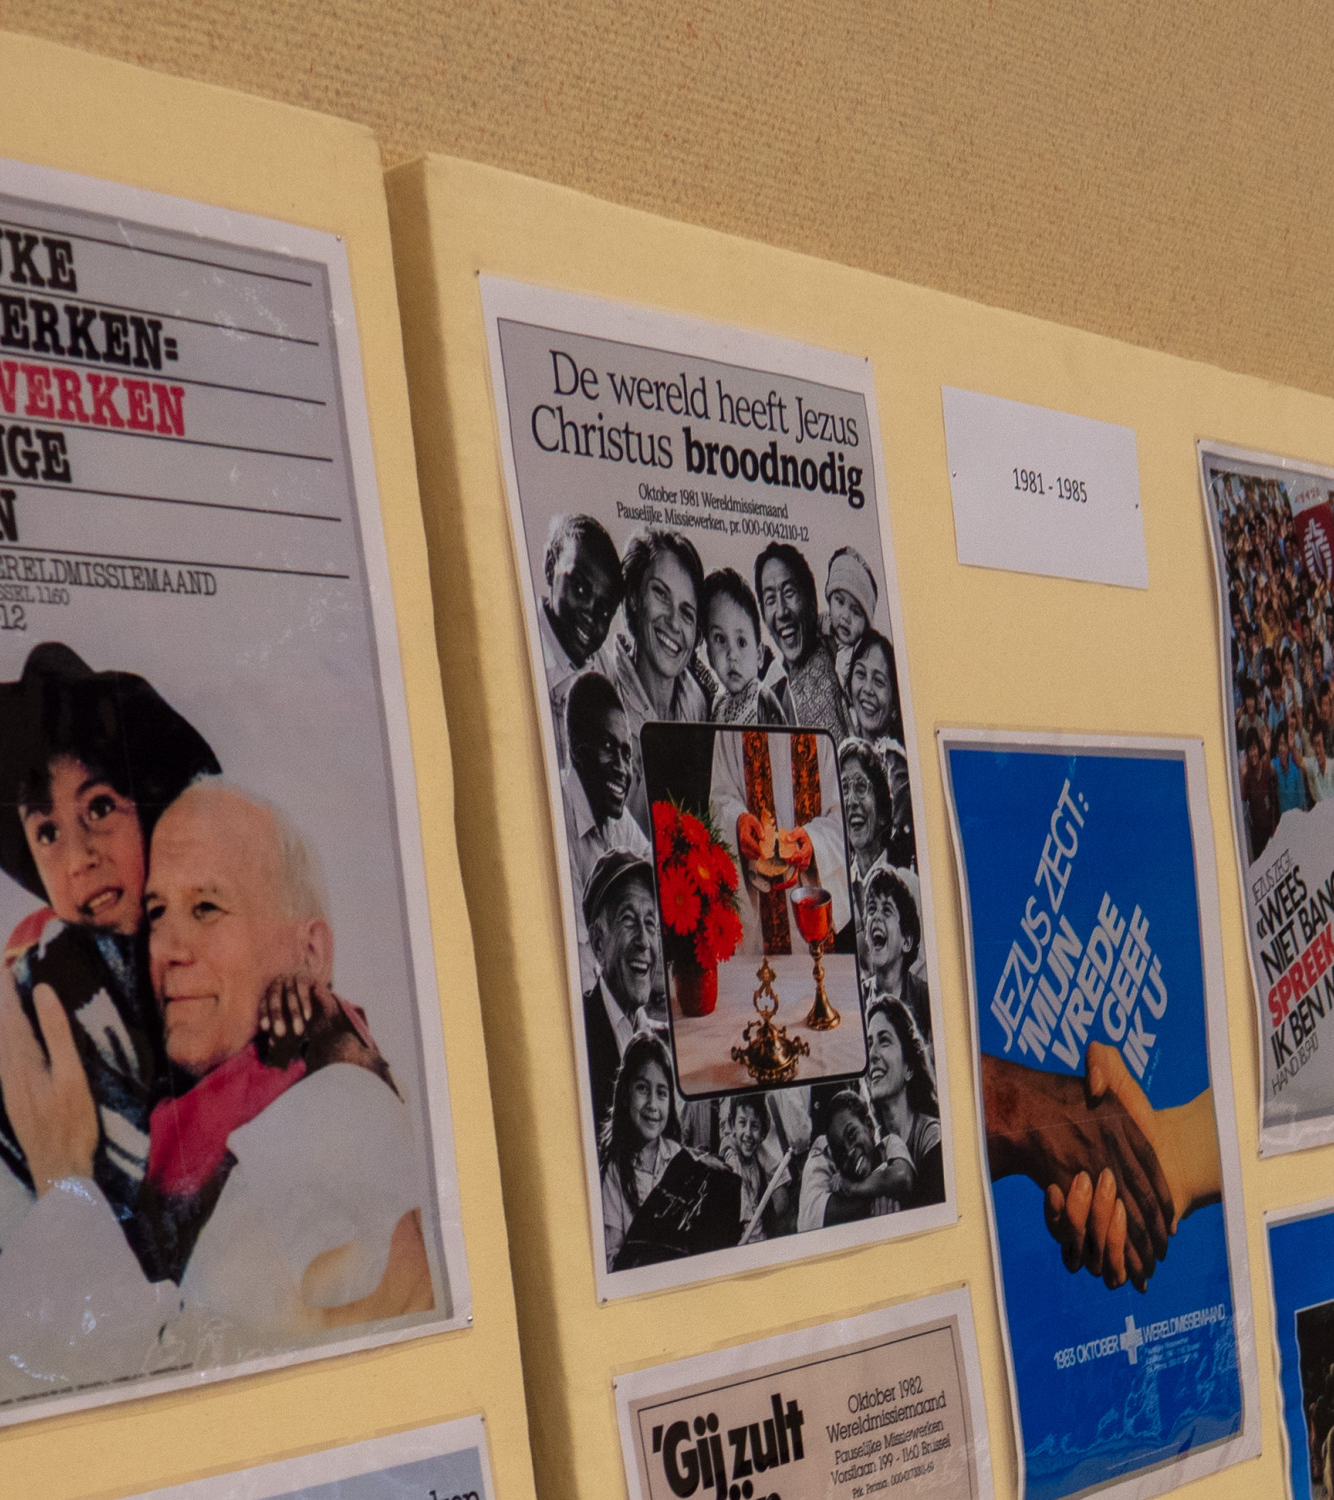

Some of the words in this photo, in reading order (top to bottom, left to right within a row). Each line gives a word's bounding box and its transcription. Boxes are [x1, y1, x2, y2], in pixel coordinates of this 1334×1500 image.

[549, 349, 599, 399] De
[607, 371, 708, 419] wereld
[716, 380, 789, 434] heeft
[795, 397, 859, 447] Jezus
[531, 404, 673, 468] Christus
[683, 427, 865, 509] broodnodig
[638, 482, 677, 506] Oktober
[679, 488, 700, 508] 1981
[702, 491, 788, 520] Wereldmissiemaand
[990, 895, 1051, 1054] JEZUS
[1034, 778, 1089, 915] ZEGT:
[1260, 919, 1300, 985] NIET
[1052, 891, 1126, 1070] VREDE
[1102, 904, 1152, 1042] GEEF
[1270, 1022, 1293, 1070] IK
[1289, 986, 1325, 1048] BEN
[1054, 1348, 1076, 1370] 1983
[1076, 1335, 1120, 1364] OKTOBER
[1143, 1303, 1225, 1343] WERELDMISSIEMAAND
[728, 1392, 805, 1481] zult
[826, 1390, 947, 1443] Wereldmissiemaand
[848, 1387, 896, 1414] Oktober
[898, 1375, 923, 1399] 1982
[834, 1439, 882, 1465] Pauselijke
[884, 1419, 944, 1450] Missiewerken
